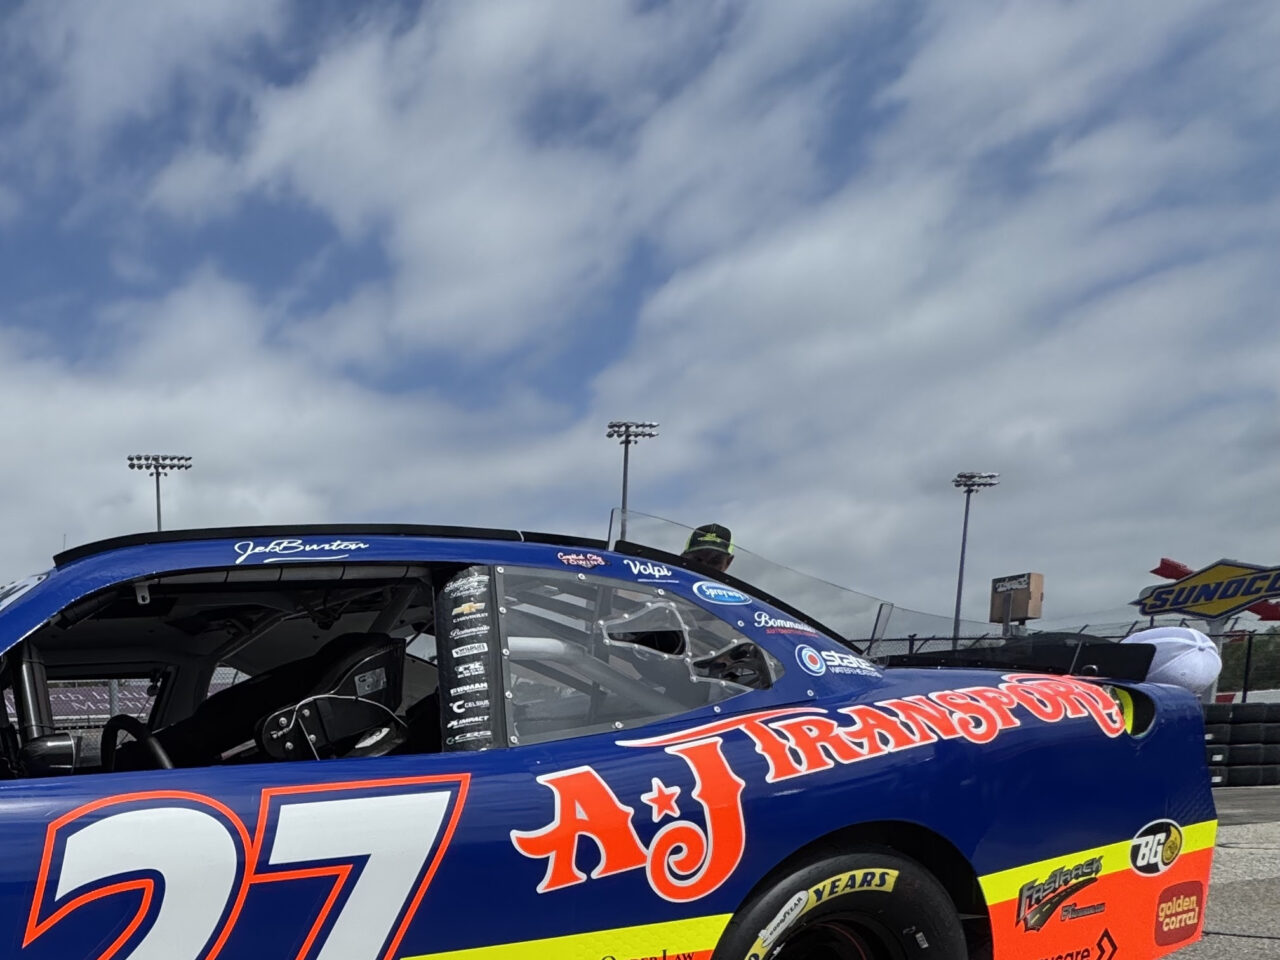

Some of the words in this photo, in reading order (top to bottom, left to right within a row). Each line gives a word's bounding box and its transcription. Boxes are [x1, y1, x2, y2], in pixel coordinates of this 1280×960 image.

[623, 559, 672, 578] Volpi
[616, 674, 1126, 783] TRANSPORT
[1134, 833, 1167, 867] BG
[812, 871, 890, 902] YEARS
[1158, 895, 1197, 921] golden
[1162, 907, 1199, 931] corral
